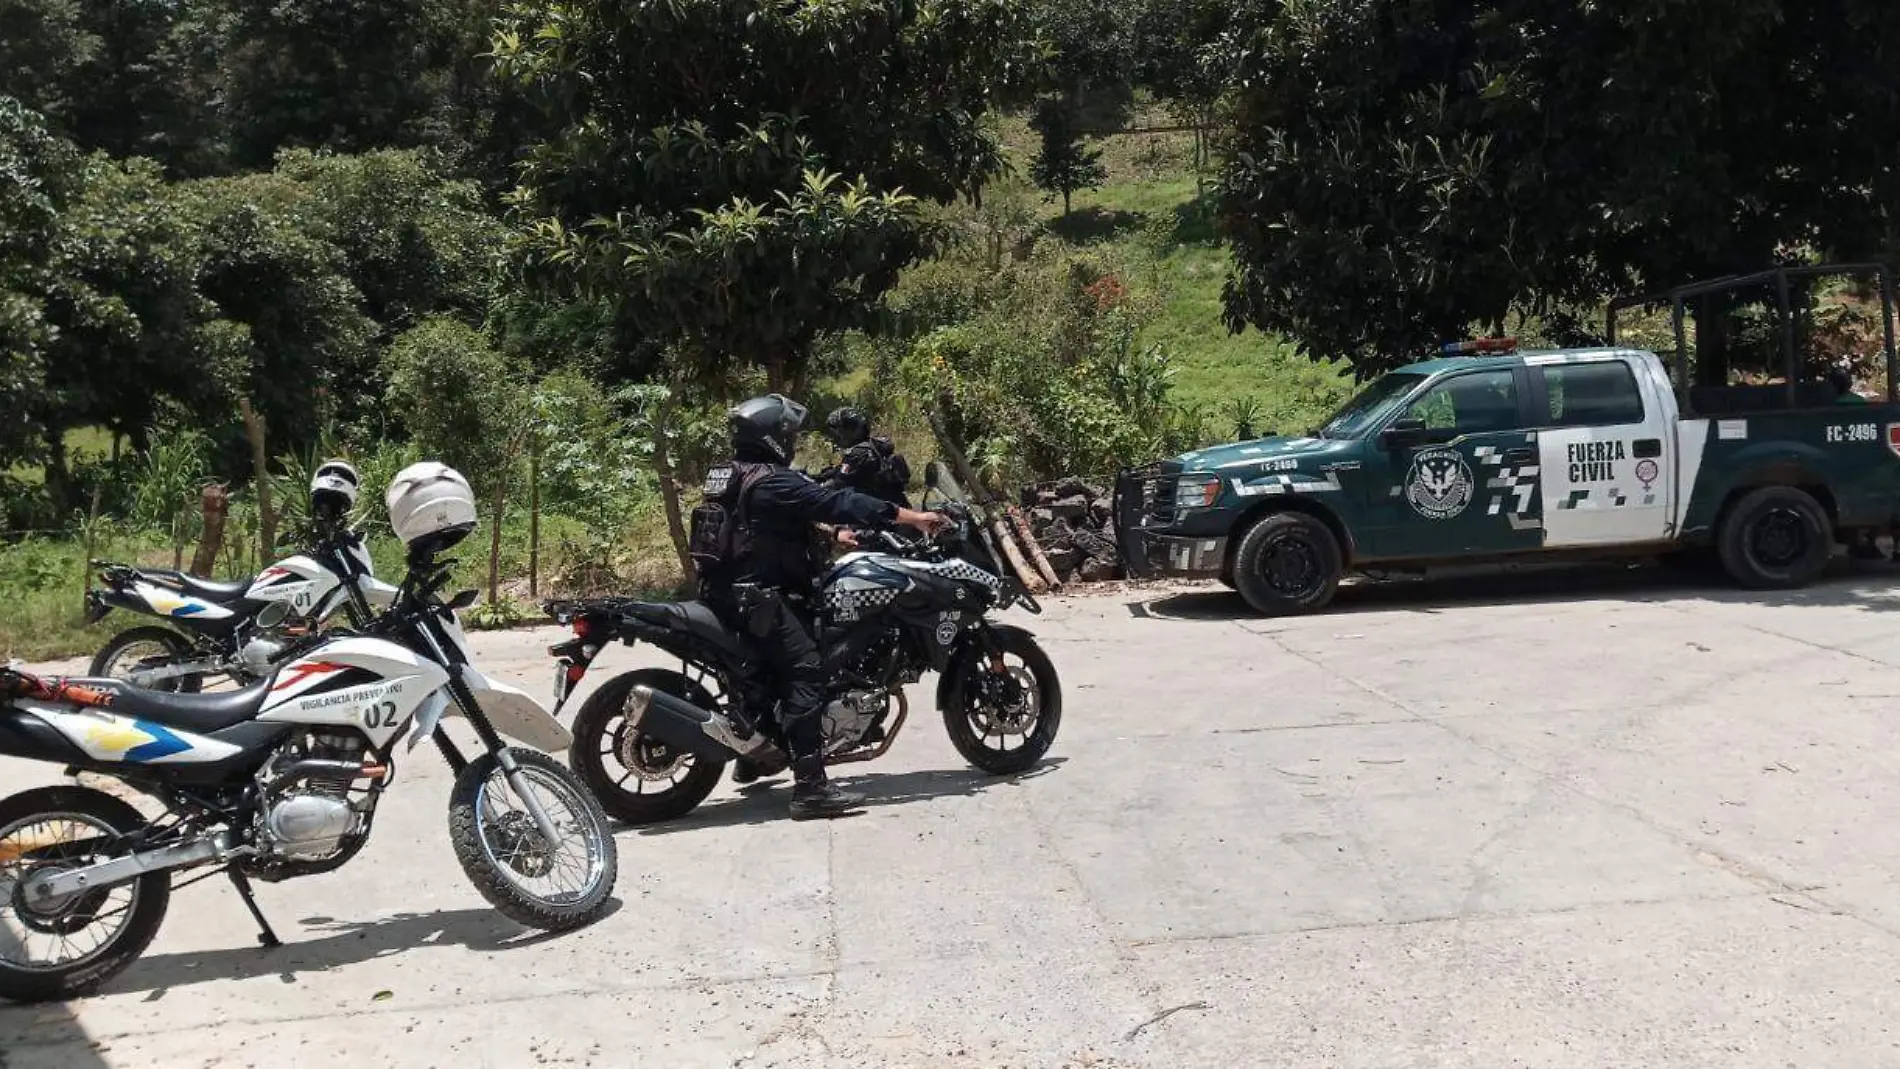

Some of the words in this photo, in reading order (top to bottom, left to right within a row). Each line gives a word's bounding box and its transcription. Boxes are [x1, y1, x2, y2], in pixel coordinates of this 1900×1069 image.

[1826, 423, 1878, 442] FC-2496
[1567, 440, 1625, 463] FUERZA
[1569, 461, 1615, 483] CIVIL
[295, 592, 311, 607] 01
[300, 694, 351, 710] VIGILANCIA
[364, 701, 398, 729] 02
